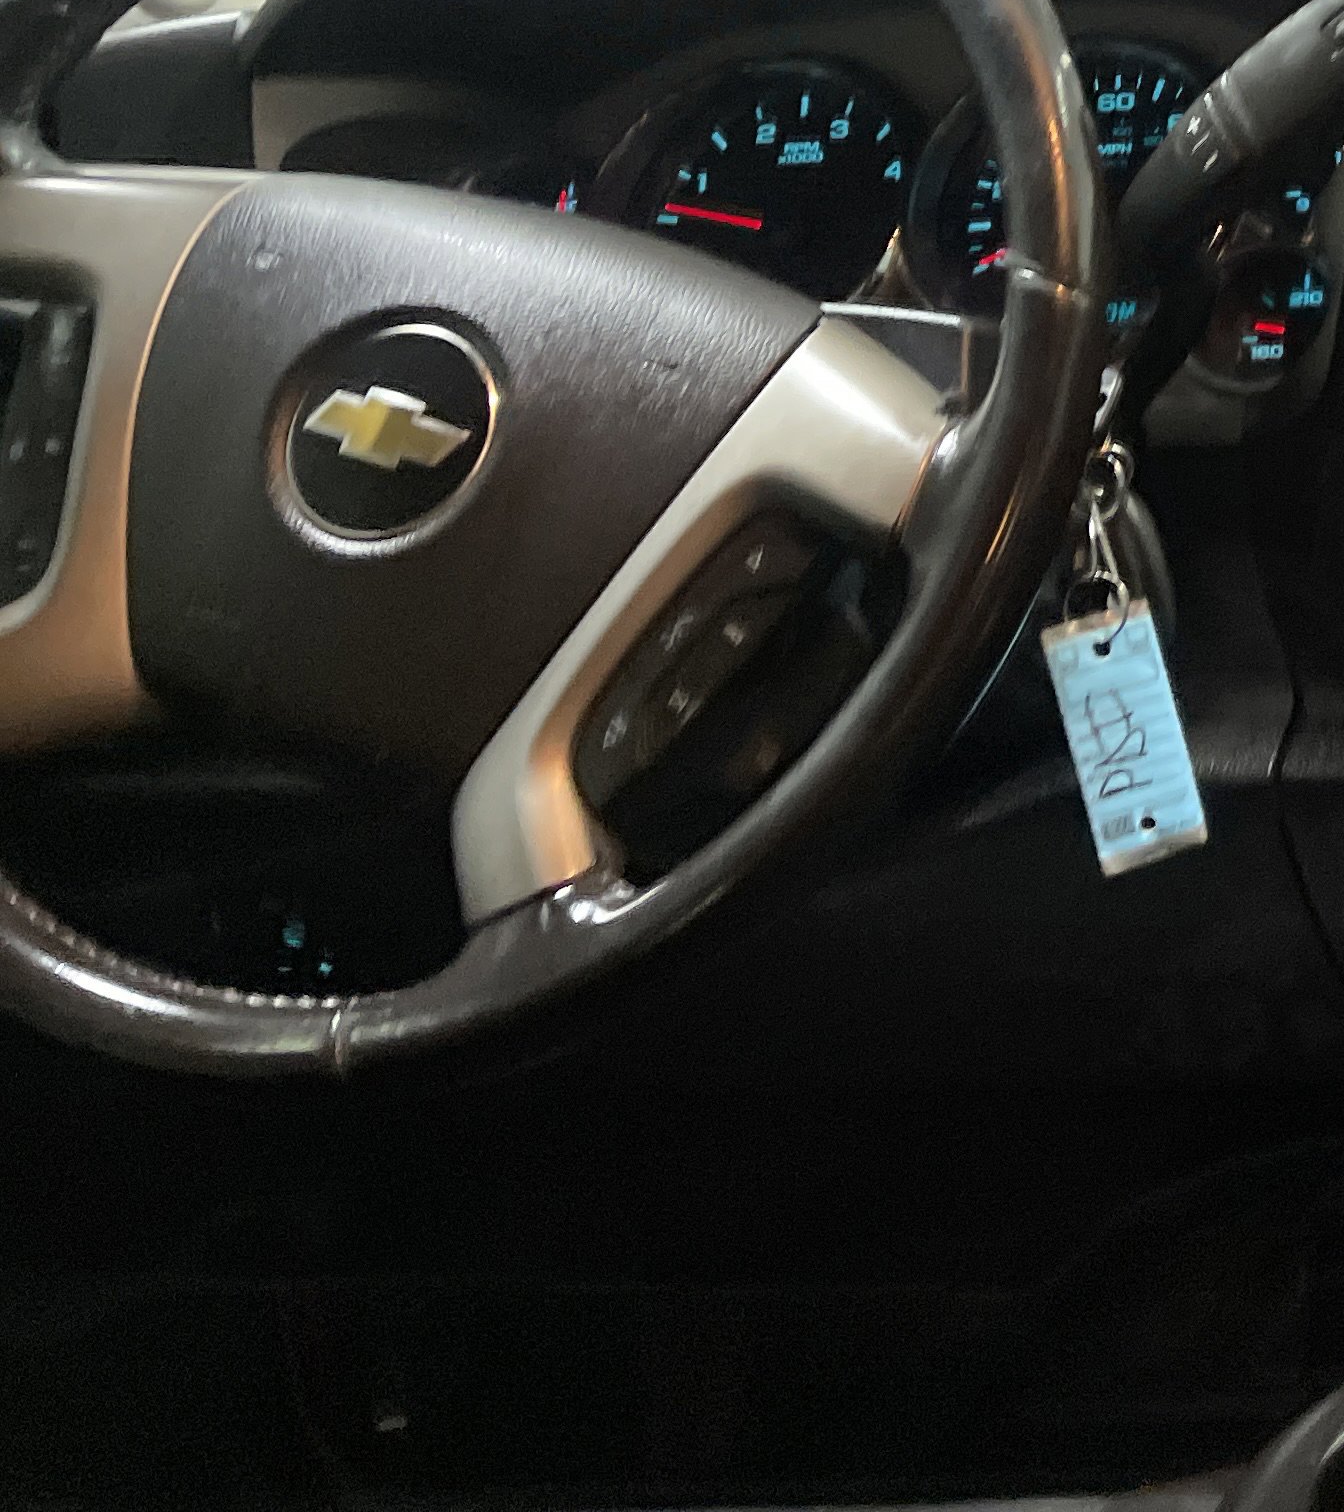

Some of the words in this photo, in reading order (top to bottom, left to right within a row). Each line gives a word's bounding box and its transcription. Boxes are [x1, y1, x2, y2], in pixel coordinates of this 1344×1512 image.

[1097, 91, 1136, 113] 60
[755, 122, 777, 145] 2
[829, 118, 850, 140] 3
[782, 140, 820, 154] RPM
[883, 159, 902, 183] 4
[697, 171, 708, 194] 1
